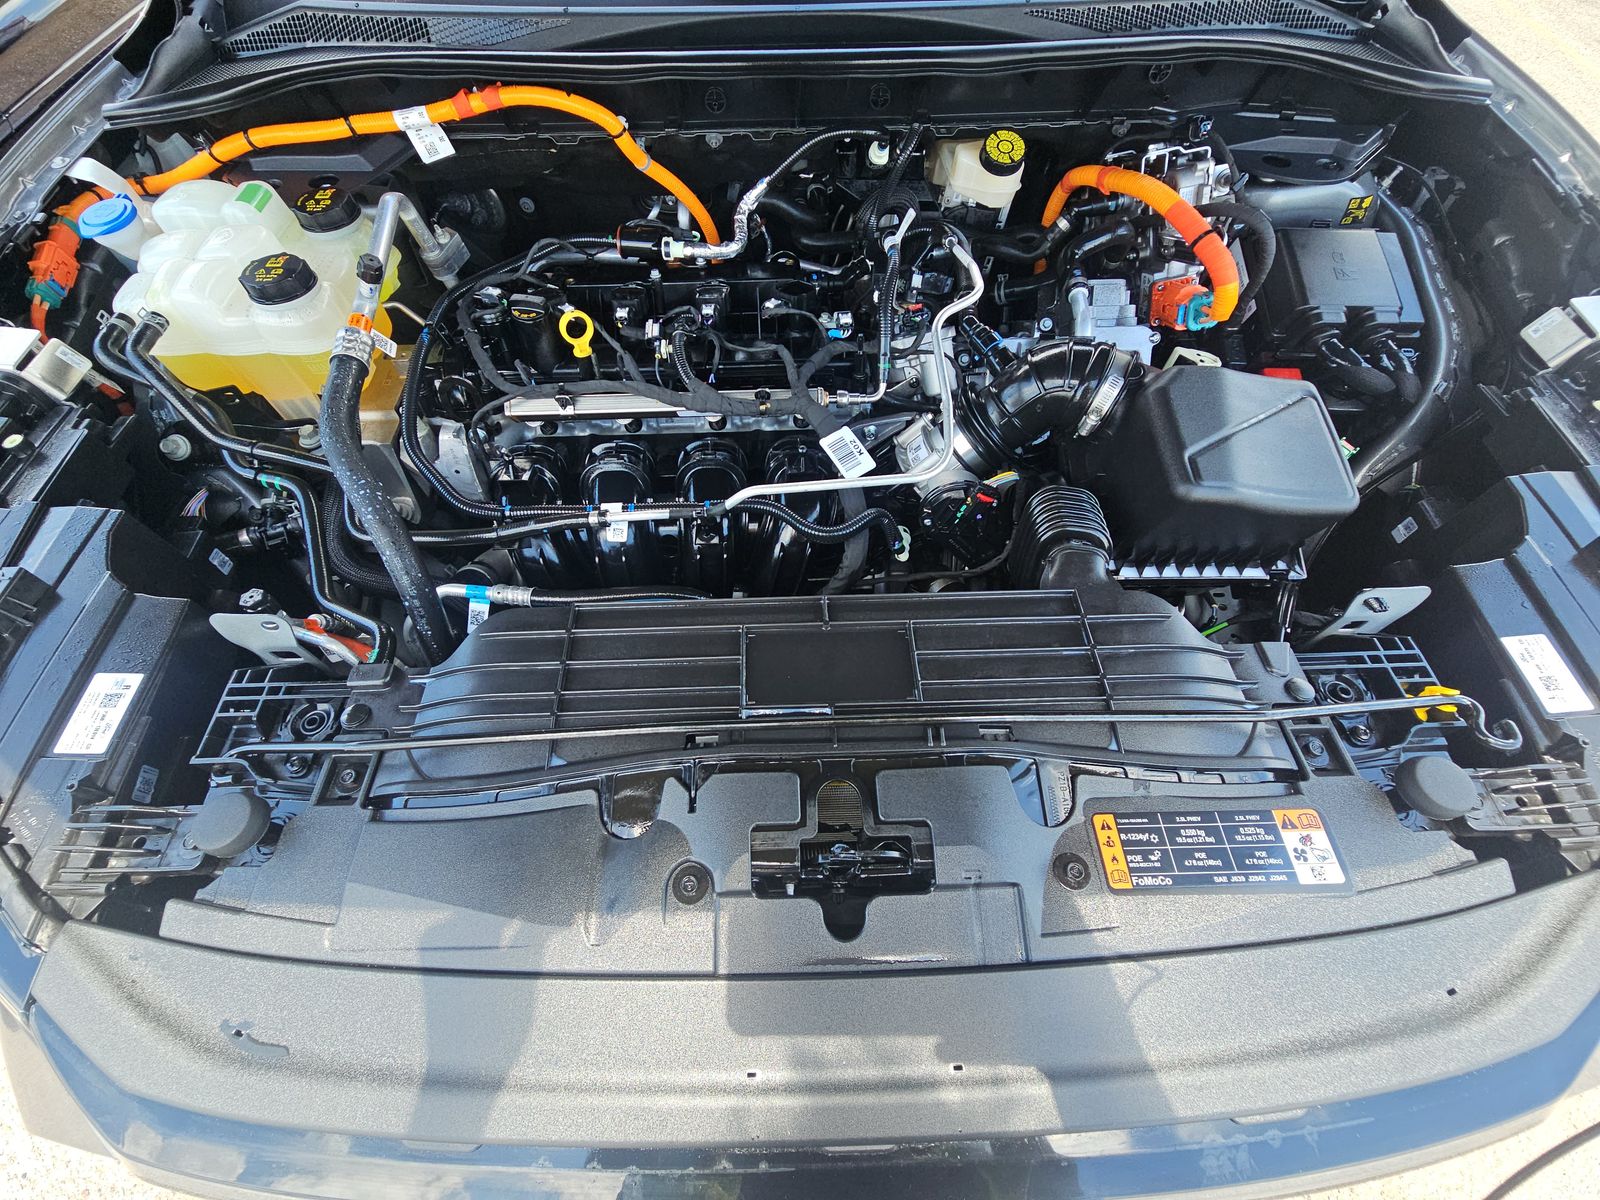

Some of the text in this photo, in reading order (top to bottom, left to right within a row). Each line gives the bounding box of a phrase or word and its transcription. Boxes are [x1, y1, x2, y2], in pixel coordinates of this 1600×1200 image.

[850, 439, 864, 456] K02
[1197, 829, 1206, 837] kg
[1256, 827, 1265, 835] kg
[1120, 832, 1149, 842] R-1234yf
[1132, 875, 1173, 886] FoMoCo
